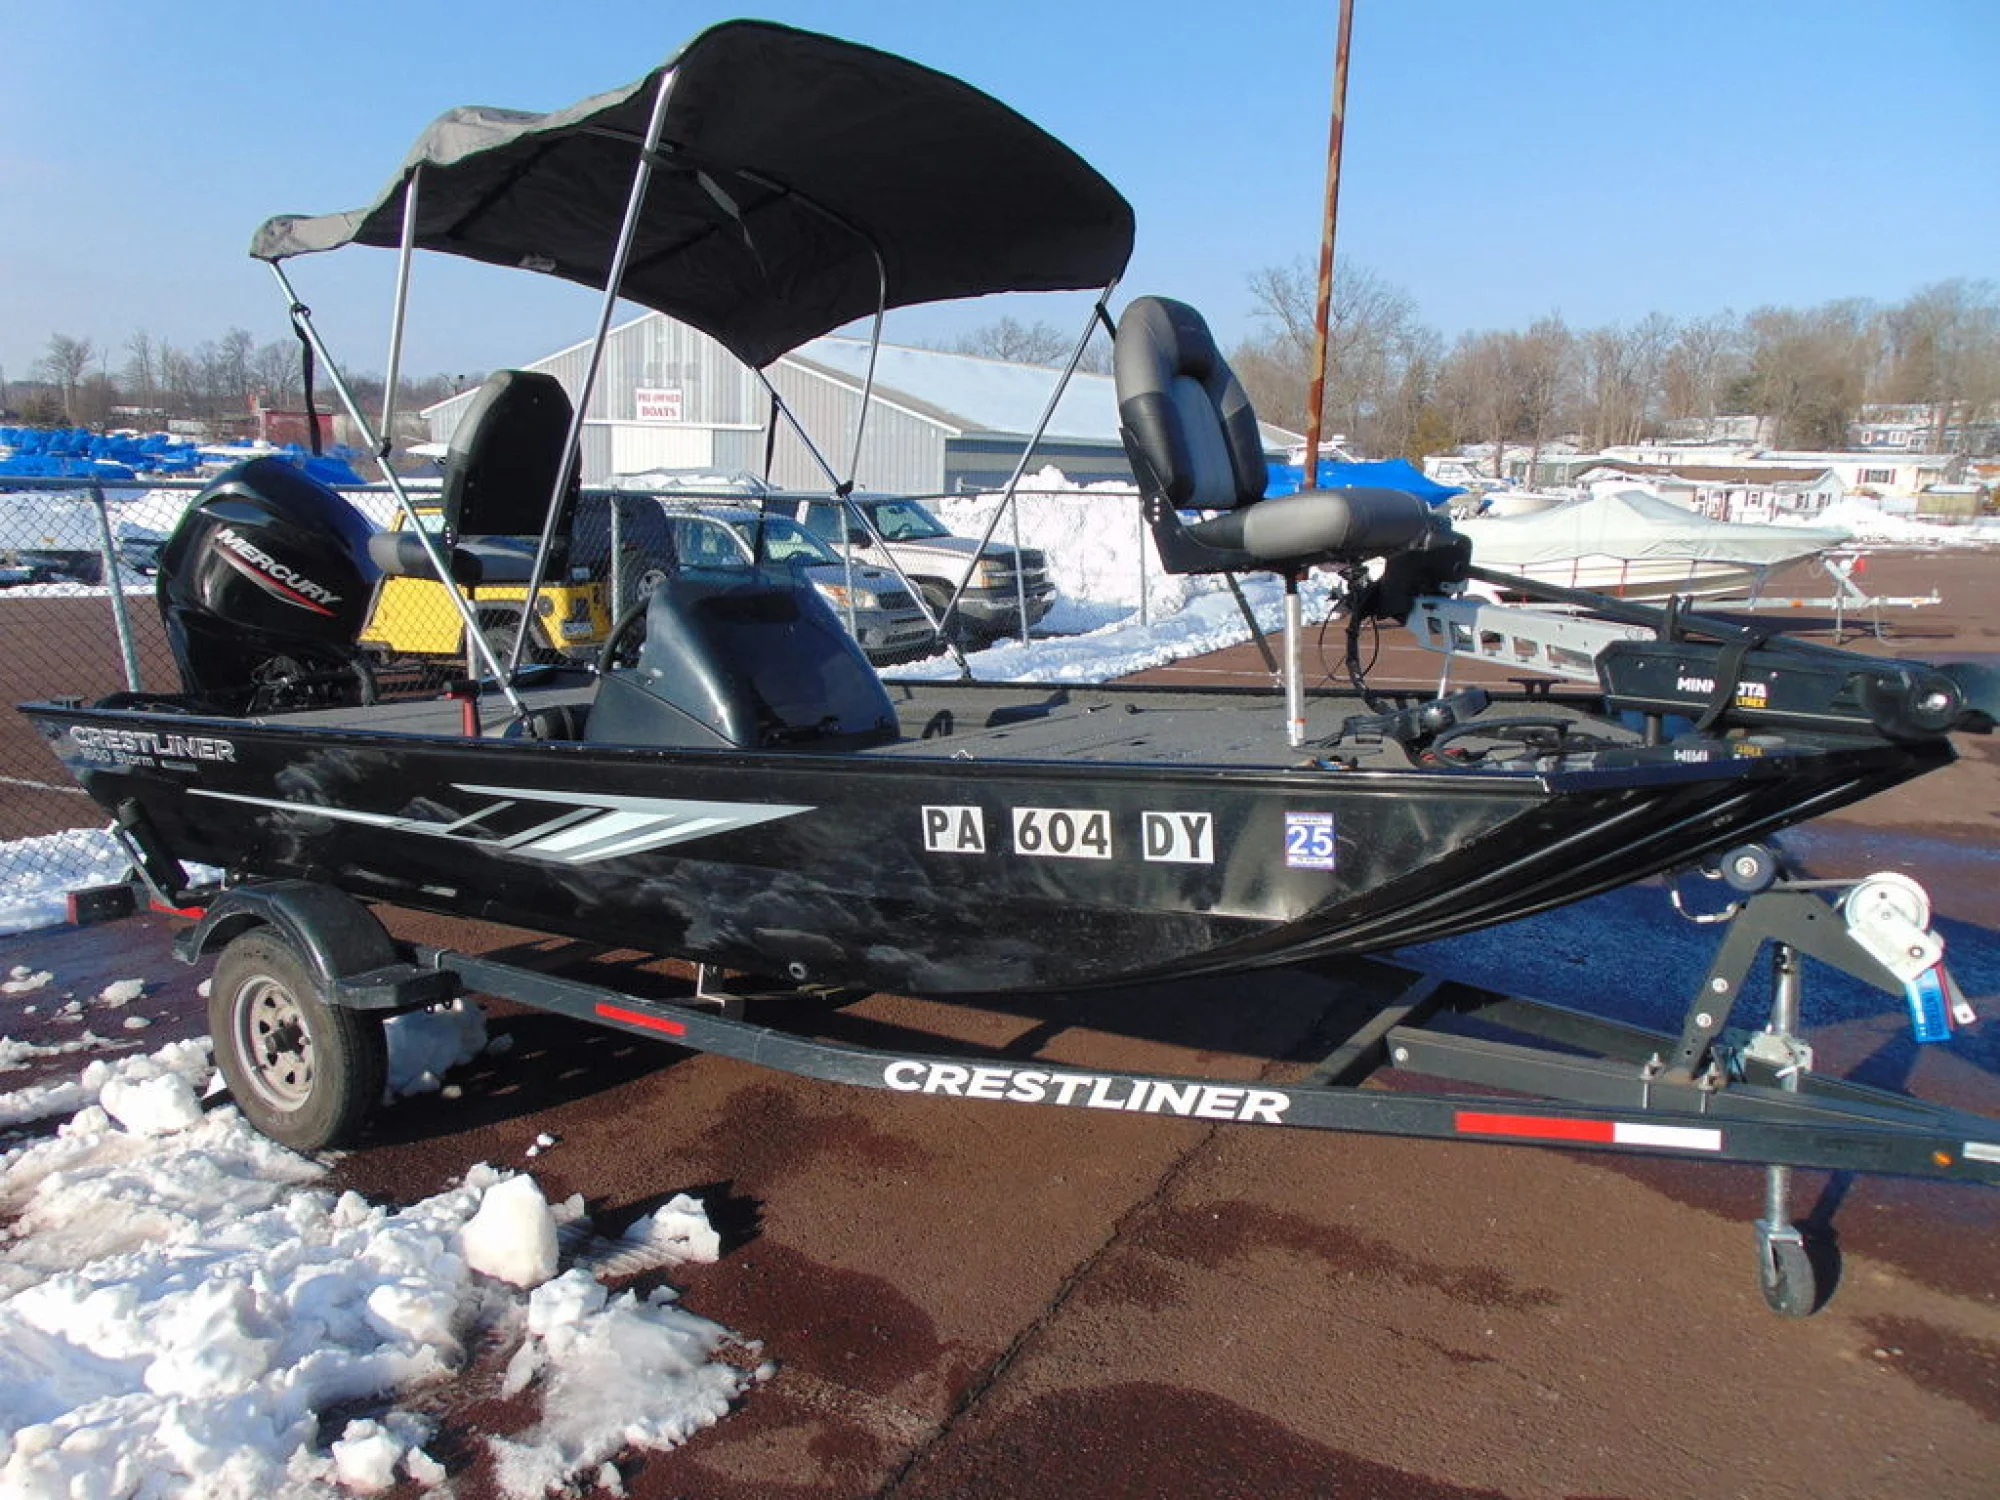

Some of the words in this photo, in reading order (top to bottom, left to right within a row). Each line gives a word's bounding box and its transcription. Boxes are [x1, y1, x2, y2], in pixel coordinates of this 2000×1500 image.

[642, 406, 676, 416] BOATS
[216, 528, 342, 604] MERCURY
[70, 725, 236, 763] CRESTLINER
[926, 807, 984, 850] PA
[1018, 810, 1109, 856] 604
[1146, 813, 1208, 859] DY
[1288, 825, 1333, 857] 25
[884, 1060, 1291, 1125] CRESTLINER
